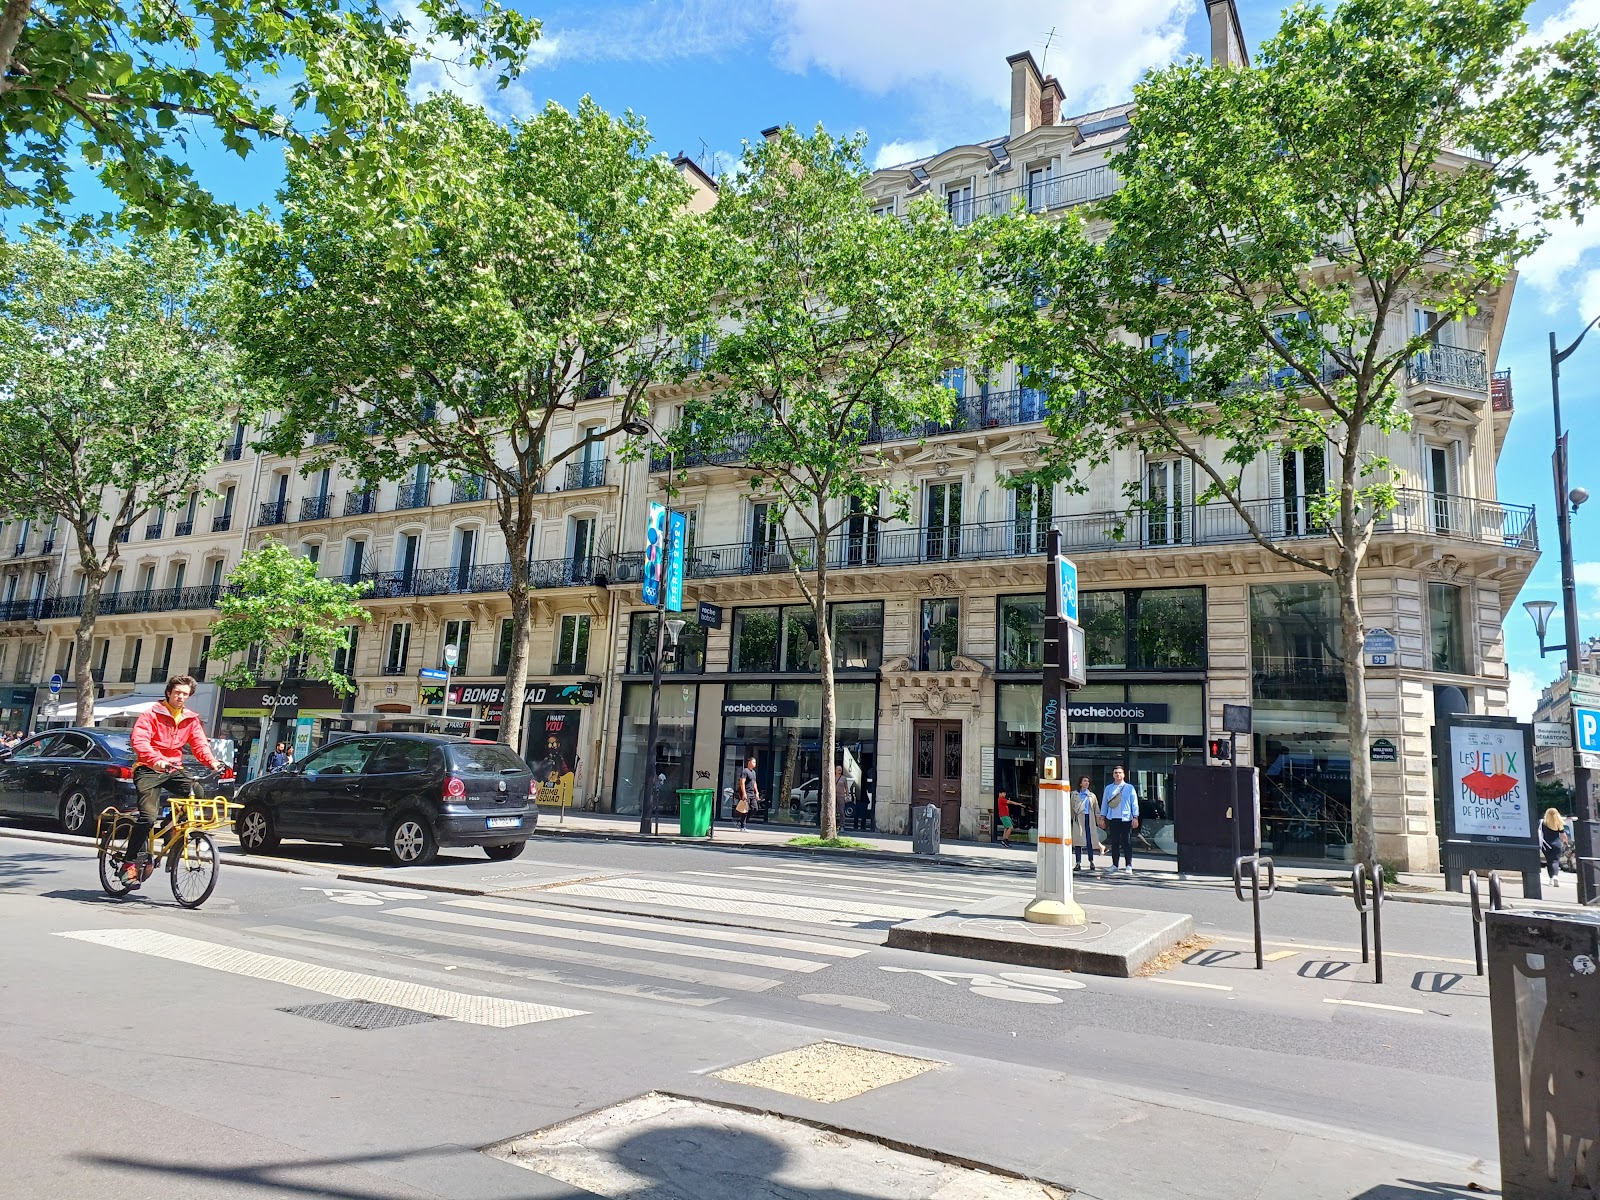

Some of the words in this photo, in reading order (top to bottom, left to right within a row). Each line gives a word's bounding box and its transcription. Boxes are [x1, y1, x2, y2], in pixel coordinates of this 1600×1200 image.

[671, 561, 680, 603] PARIS
[701, 607, 717, 615] roche
[700, 614, 717, 623] bobois
[446, 648, 457, 657] BUS
[1374, 655, 1385, 664] 92
[462, 688, 500, 703] BOMB
[724, 703, 778, 713] rochebobois
[1068, 706, 1145, 718] rochebobois
[549, 714, 566, 722] WANT
[545, 721, 564, 731] YOU
[1583, 714, 1597, 746] P
[1459, 751, 1475, 765] LES
[1471, 750, 1517, 776] JEUX
[540, 788, 559, 796] BOMB
[539, 795, 560, 803] SQUAD
[1462, 805, 1472, 817] DE
